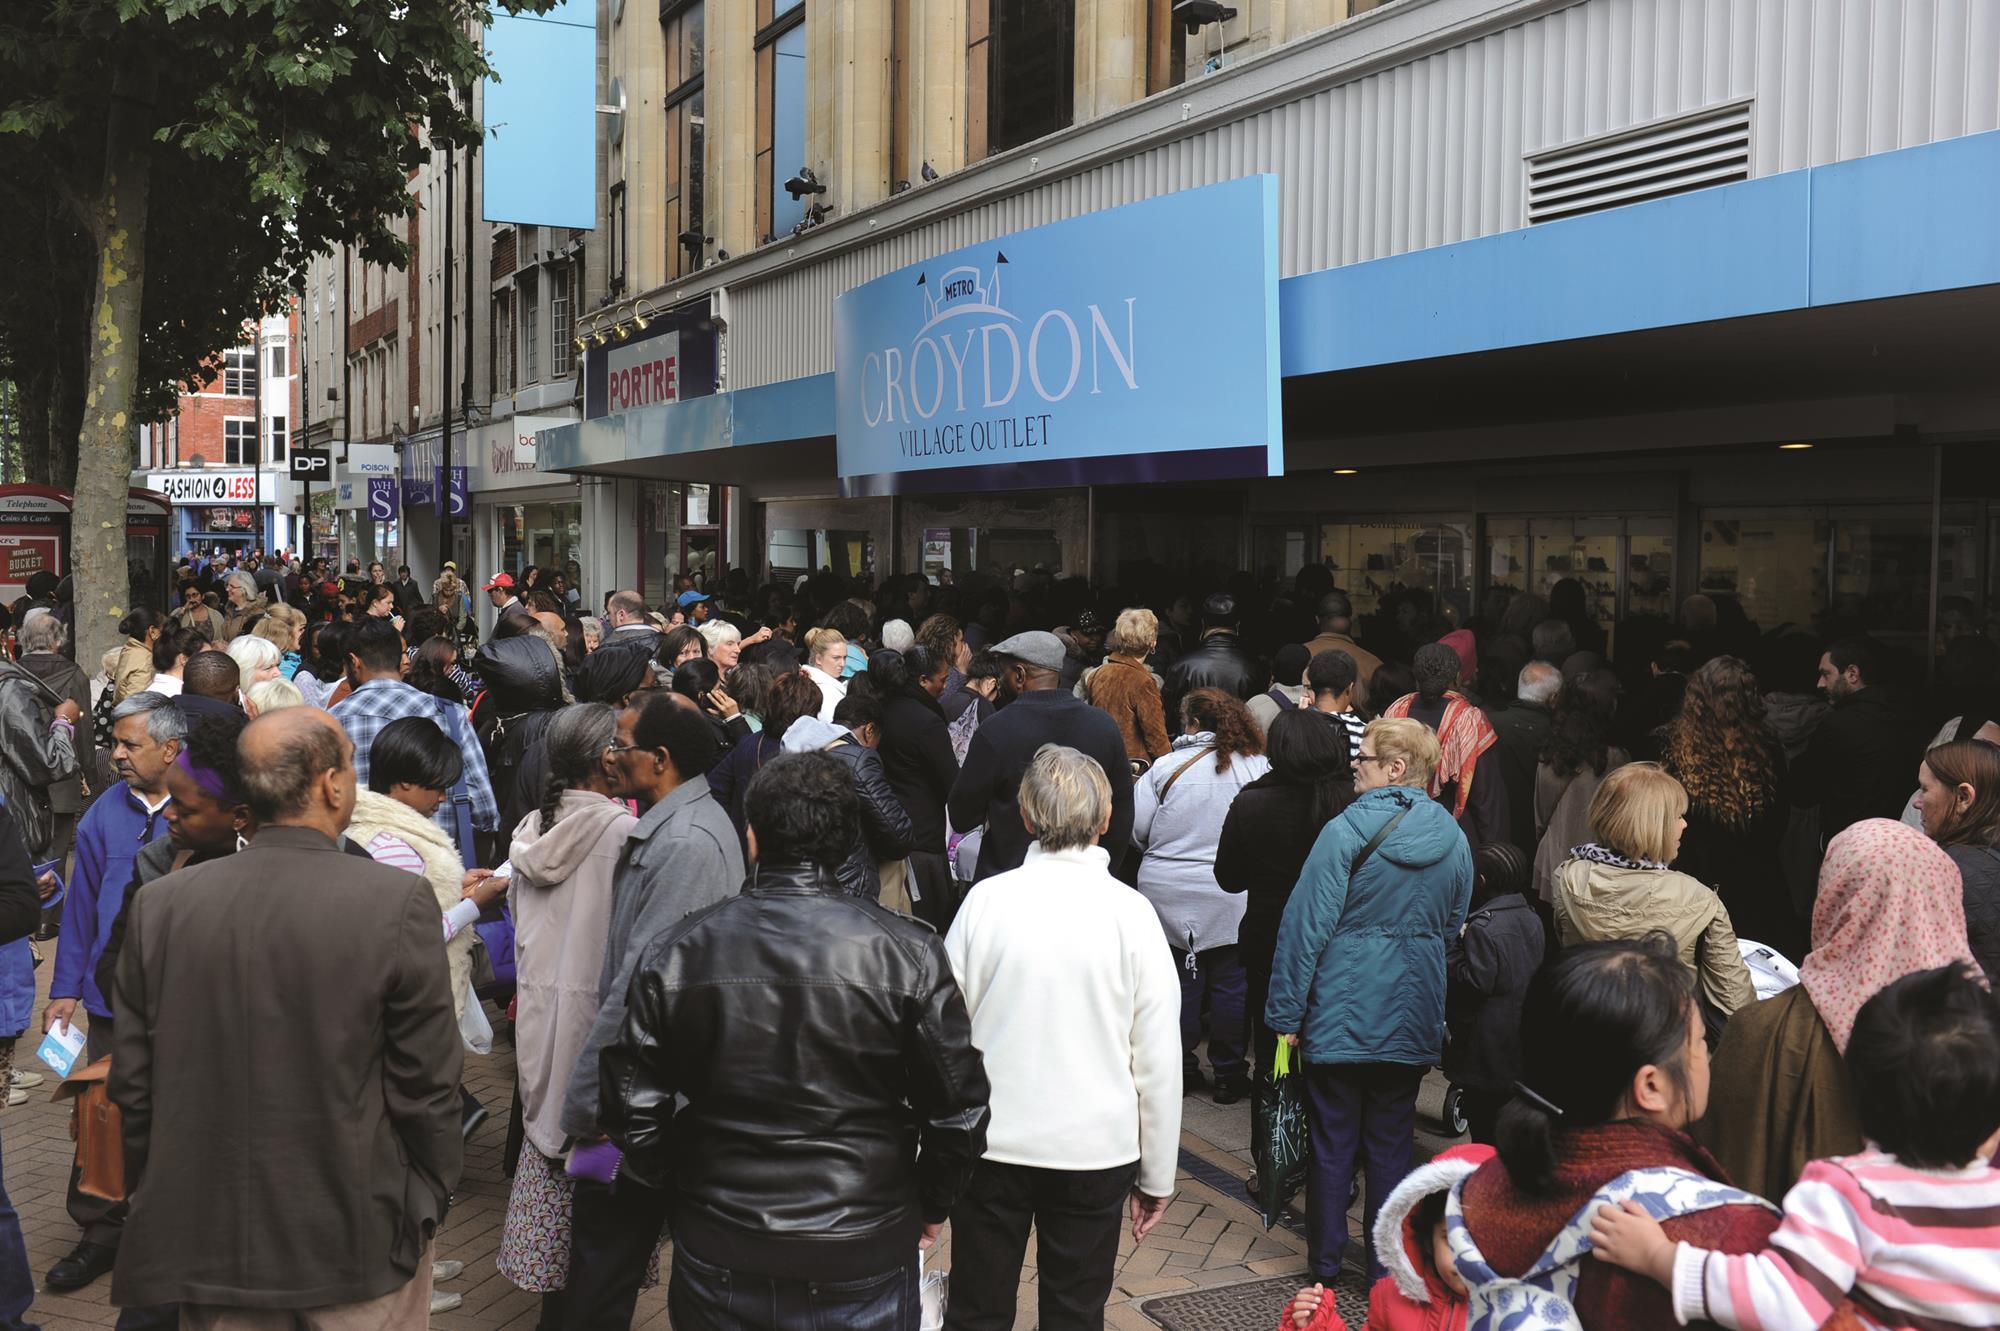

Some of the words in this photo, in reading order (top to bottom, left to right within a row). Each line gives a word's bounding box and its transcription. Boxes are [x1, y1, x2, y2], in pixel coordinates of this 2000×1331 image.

[944, 279, 975, 301] METRO
[860, 296, 1139, 428] CROYDON
[609, 356, 676, 411] PORTRE
[898, 423, 966, 458] VILLAGE
[970, 413, 1053, 451] OUTLET
[294, 457, 327, 471] DP
[164, 478, 210, 499] FASHION
[214, 479, 224, 497] 4
[228, 477, 255, 499] LESS
[372, 481, 391, 490] WH
[6, 499, 48, 510] Telephone
[372, 490, 391, 518] S
[9, 556, 43, 570] BUCKET
